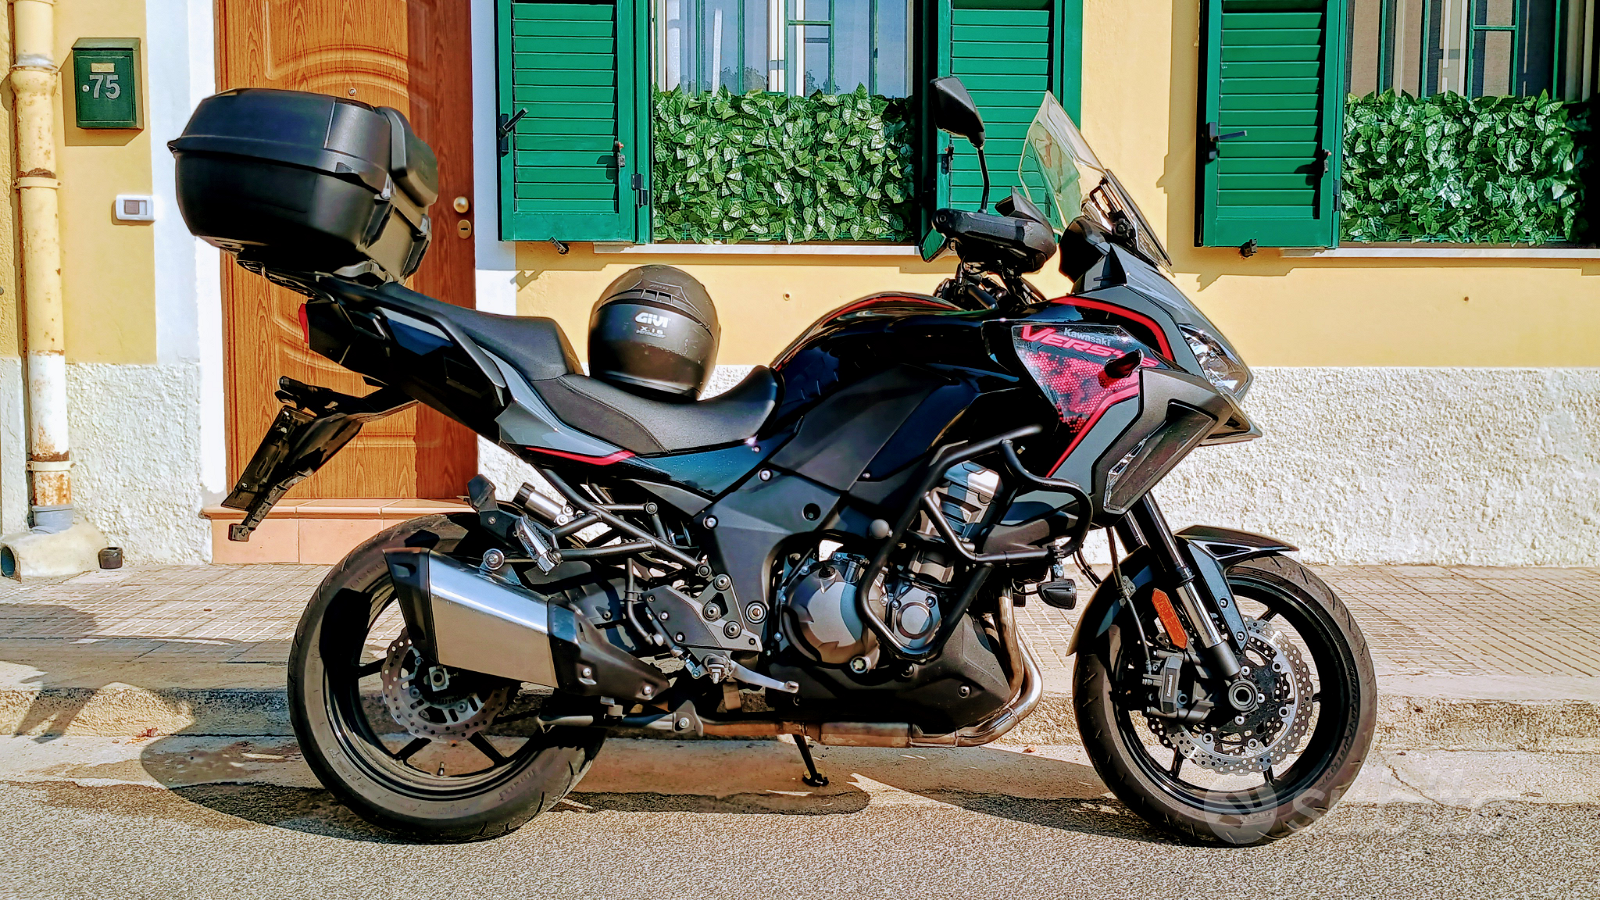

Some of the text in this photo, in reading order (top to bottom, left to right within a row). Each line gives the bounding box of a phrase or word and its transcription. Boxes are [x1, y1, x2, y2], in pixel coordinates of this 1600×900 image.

[89, 75, 121, 99] 75
[635, 312, 670, 328] GIVI
[1064, 328, 1110, 346] Kawasaki
